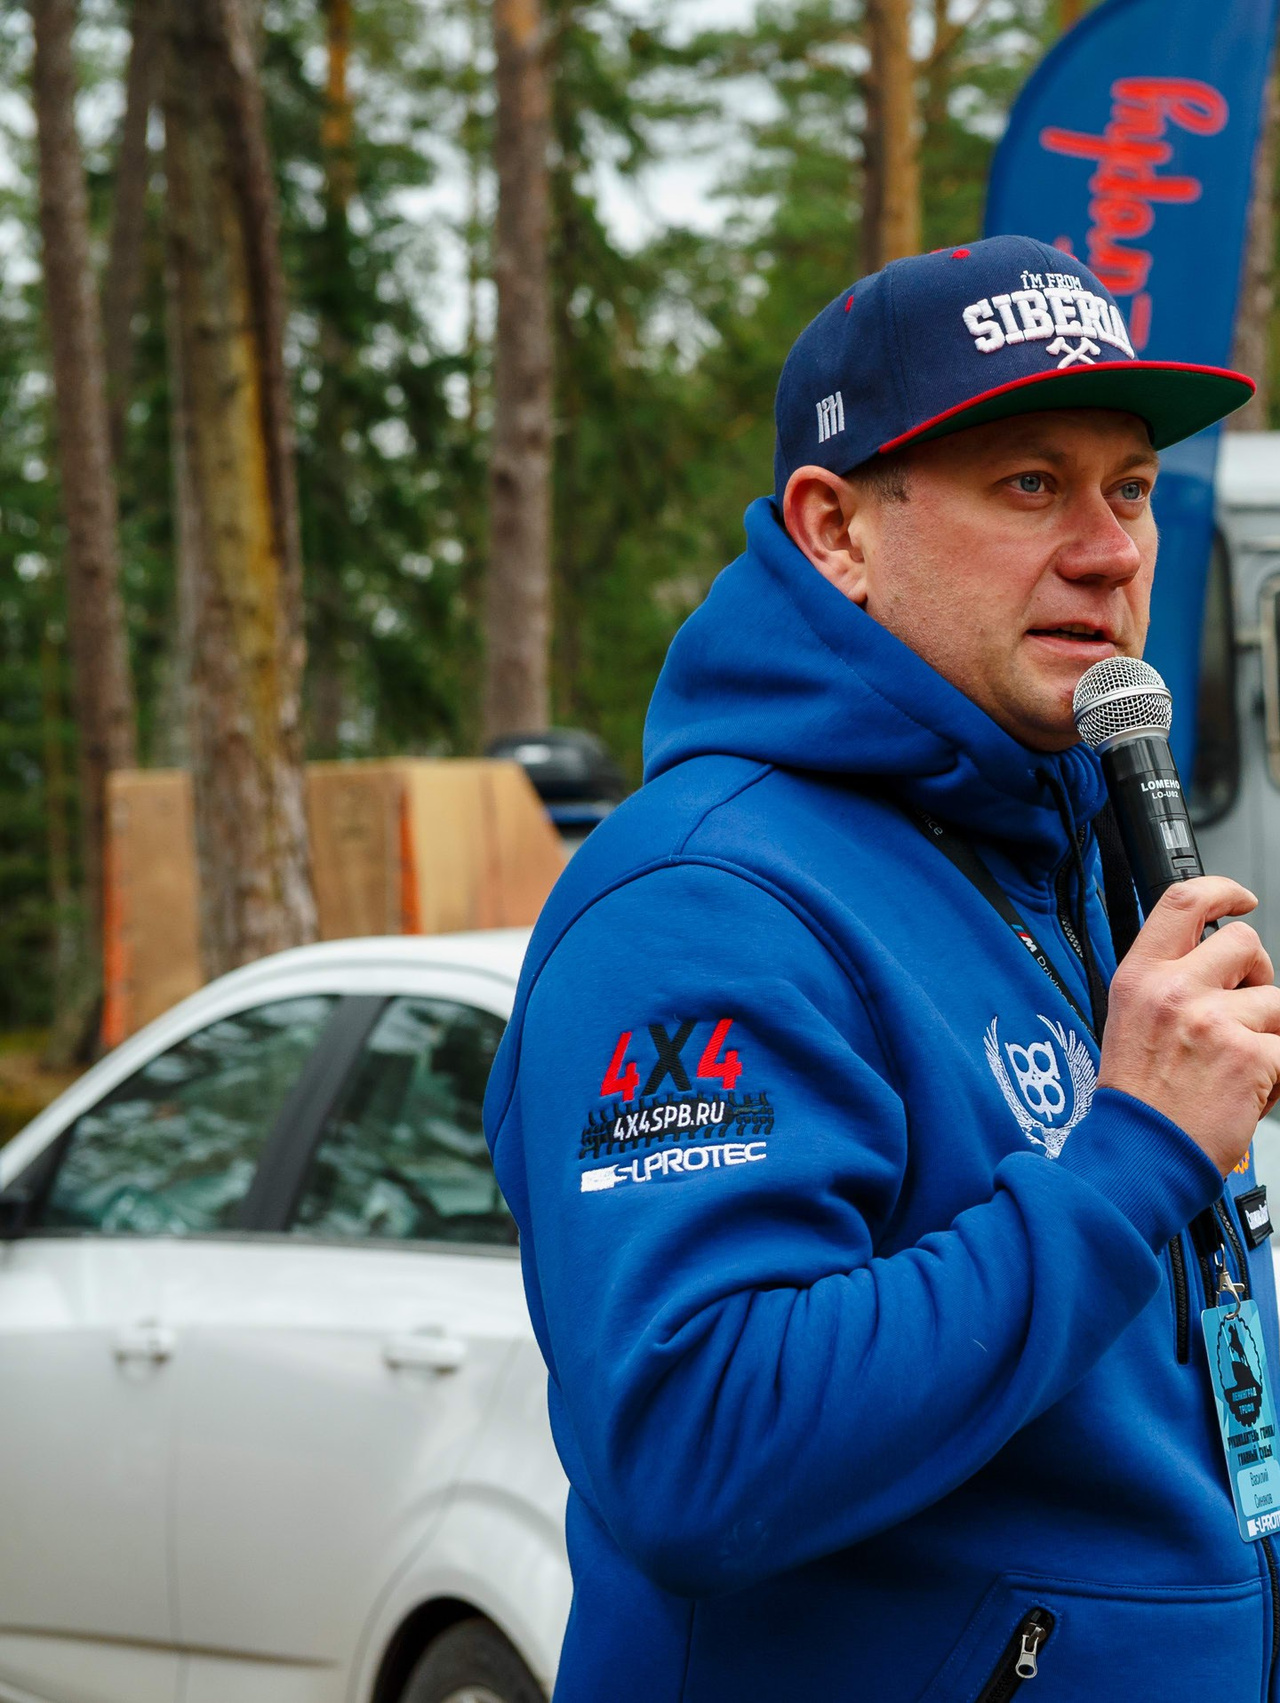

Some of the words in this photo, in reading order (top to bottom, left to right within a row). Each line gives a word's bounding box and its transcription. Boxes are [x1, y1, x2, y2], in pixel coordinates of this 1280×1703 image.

[1045, 272, 1083, 291] FROM
[963, 287, 1135, 359] SIBERIA
[600, 1018, 742, 1102] 4X4
[613, 1101, 726, 1140] 4X4SPB.RU
